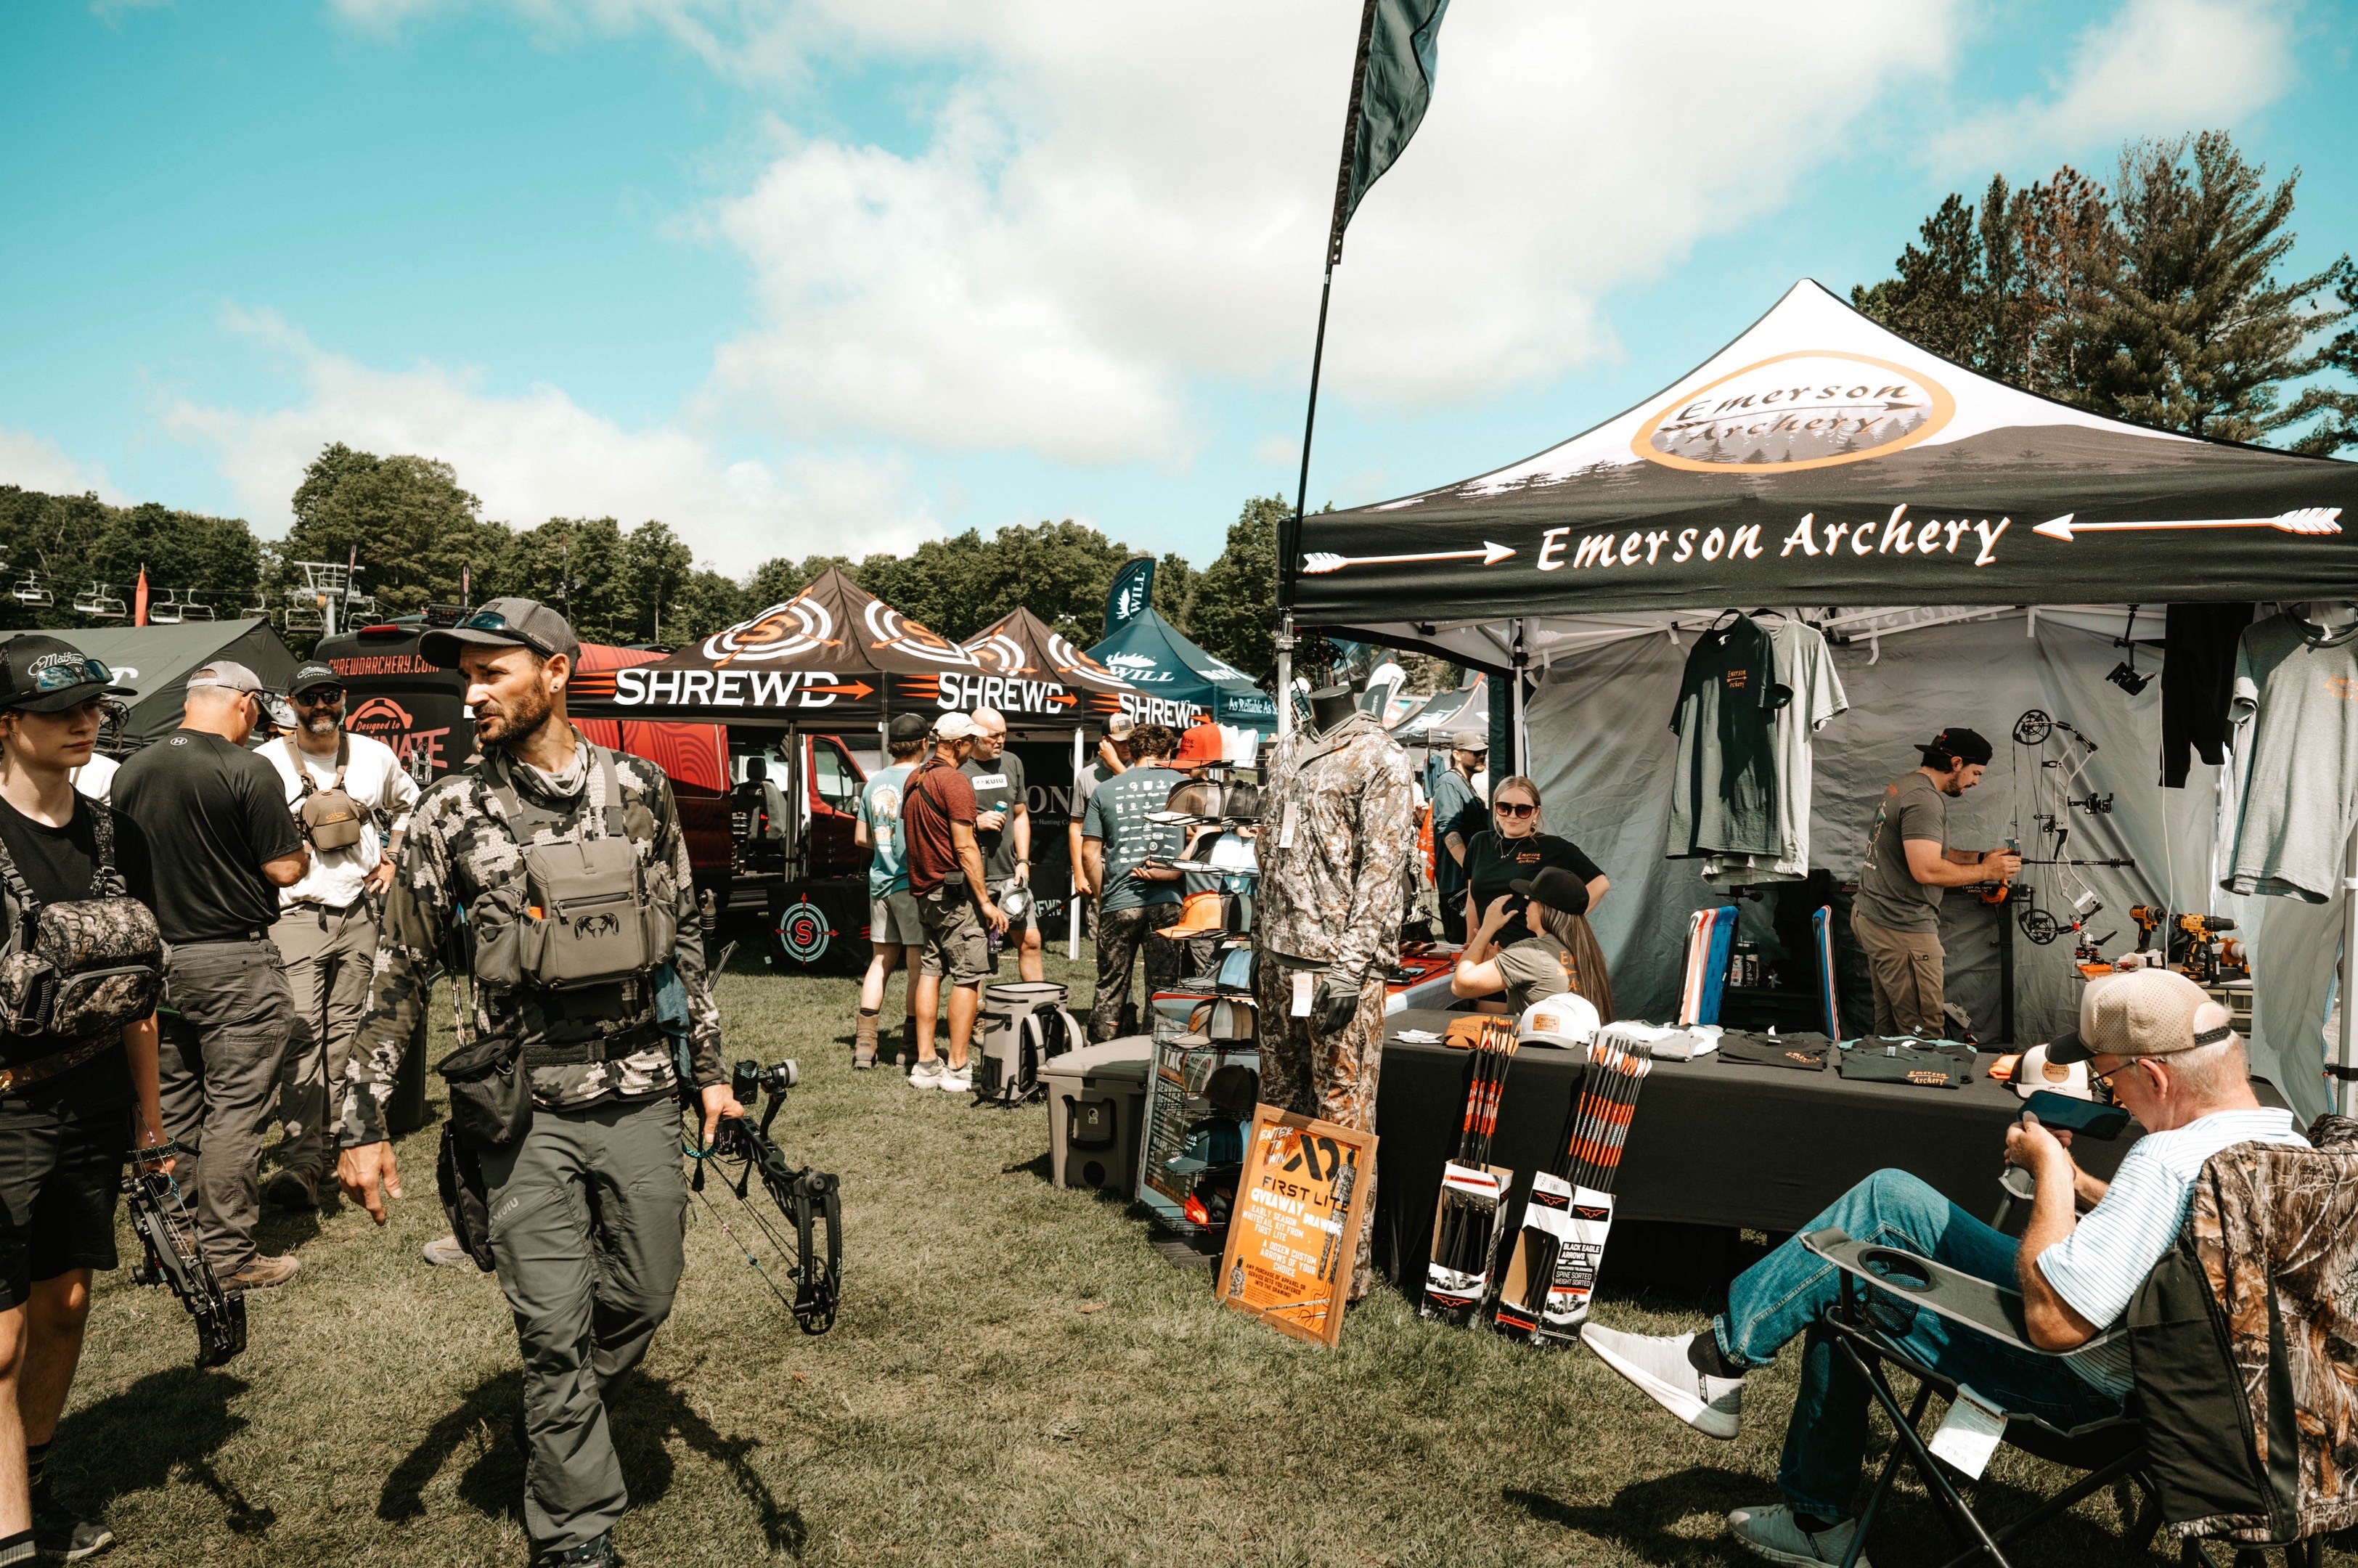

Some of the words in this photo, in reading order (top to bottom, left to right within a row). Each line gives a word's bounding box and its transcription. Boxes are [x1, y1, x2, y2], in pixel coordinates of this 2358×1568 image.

[1676, 385, 1912, 421] Emerson
[1684, 413, 1885, 445] Archery
[1537, 523, 1764, 572] Emerson
[1780, 502, 2012, 568] Archery
[1130, 572, 1146, 616] WILL
[1109, 665, 1175, 682] WILL
[613, 668, 839, 708] SHREWD
[937, 671, 1064, 714] SHREWD
[1118, 693, 1202, 729] SHREWD
[1228, 697, 1238, 711] As
[1239, 698, 1263, 713] Reliable
[1263, 701, 1272, 714] As
[356, 720, 391, 734] Designed
[392, 720, 400, 730] to
[1026, 785, 1073, 814] ON
[795, 920, 814, 944] S
[1913, 1077, 1945, 1085] Archery
[1259, 1127, 1294, 1140] ENTER
[1268, 1149, 1289, 1164] WIN
[1271, 1140, 1282, 1151] TO
[1262, 1175, 1310, 1201] FIRST
[1314, 1191, 1349, 1213] LITE
[497, 1197, 519, 1220] KUIU
[1250, 1187, 1305, 1217] GIVEAWAY
[1302, 1212, 1342, 1235] DRAWING
[1251, 1205, 1271, 1217] EARLY
[1273, 1212, 1297, 1227] SEASON
[1242, 1210, 1273, 1228] WHITETAIL
[1275, 1222, 1286, 1233] KIT
[1286, 1226, 1304, 1239] FROM
[1255, 1224, 1271, 1236] FIRST
[1273, 1230, 1287, 1242] LITE
[1262, 1239, 1267, 1248] A
[1269, 1241, 1289, 1256] DOZEN
[1291, 1248, 1317, 1265] CUSTOM
[1561, 1251, 1586, 1260] ARROWS
[1563, 1243, 1582, 1251] BLACK
[1581, 1244, 1600, 1253] EAGLE
[1260, 1247, 1286, 1263] ARROWS
[1287, 1258, 1297, 1267] OF
[1299, 1261, 1316, 1275] YOUR
[1273, 1262, 1297, 1278] CHOICE
[1248, 1270, 1264, 1281] SERVICE
[1264, 1276, 1274, 1285] GETS
[1284, 1284, 1302, 1296] ENTERED
[1255, 1266, 1275, 1278] PURCHASE
[1281, 1277, 1299, 1289] APPAREL
[1571, 1271, 1592, 1281] SORTED
[1272, 1286, 1292, 1299] DRAWING!
